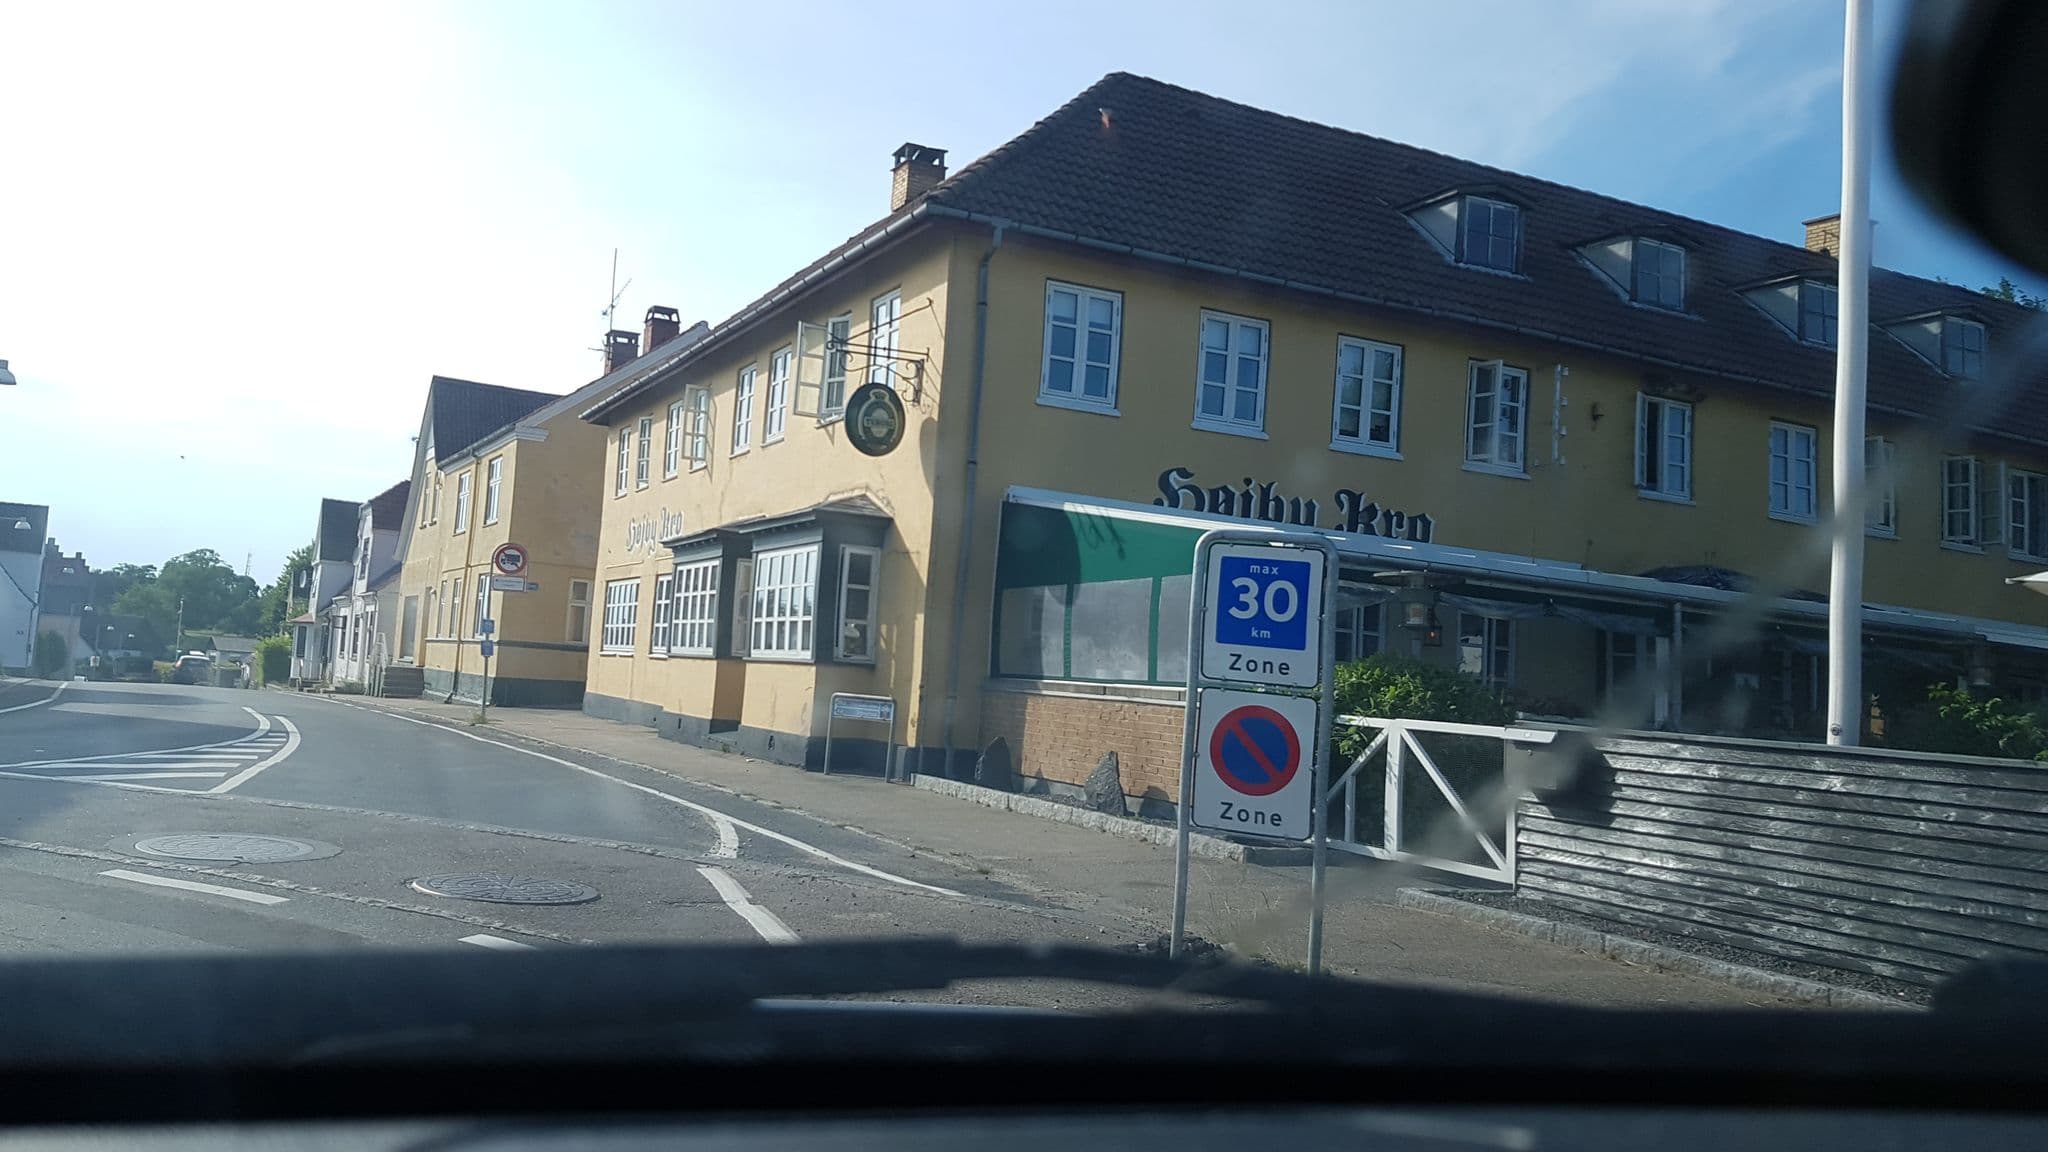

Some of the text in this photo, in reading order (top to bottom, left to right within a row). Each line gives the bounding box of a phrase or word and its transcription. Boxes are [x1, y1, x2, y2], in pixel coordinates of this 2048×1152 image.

[660, 506, 684, 541] Kro
[1334, 489, 1433, 543] Kro
[1250, 564, 1279, 576] max
[1228, 577, 1298, 623] 30
[1251, 626, 1271, 639] km
[1229, 653, 1290, 676] Zone
[1220, 801, 1282, 827] Zone
